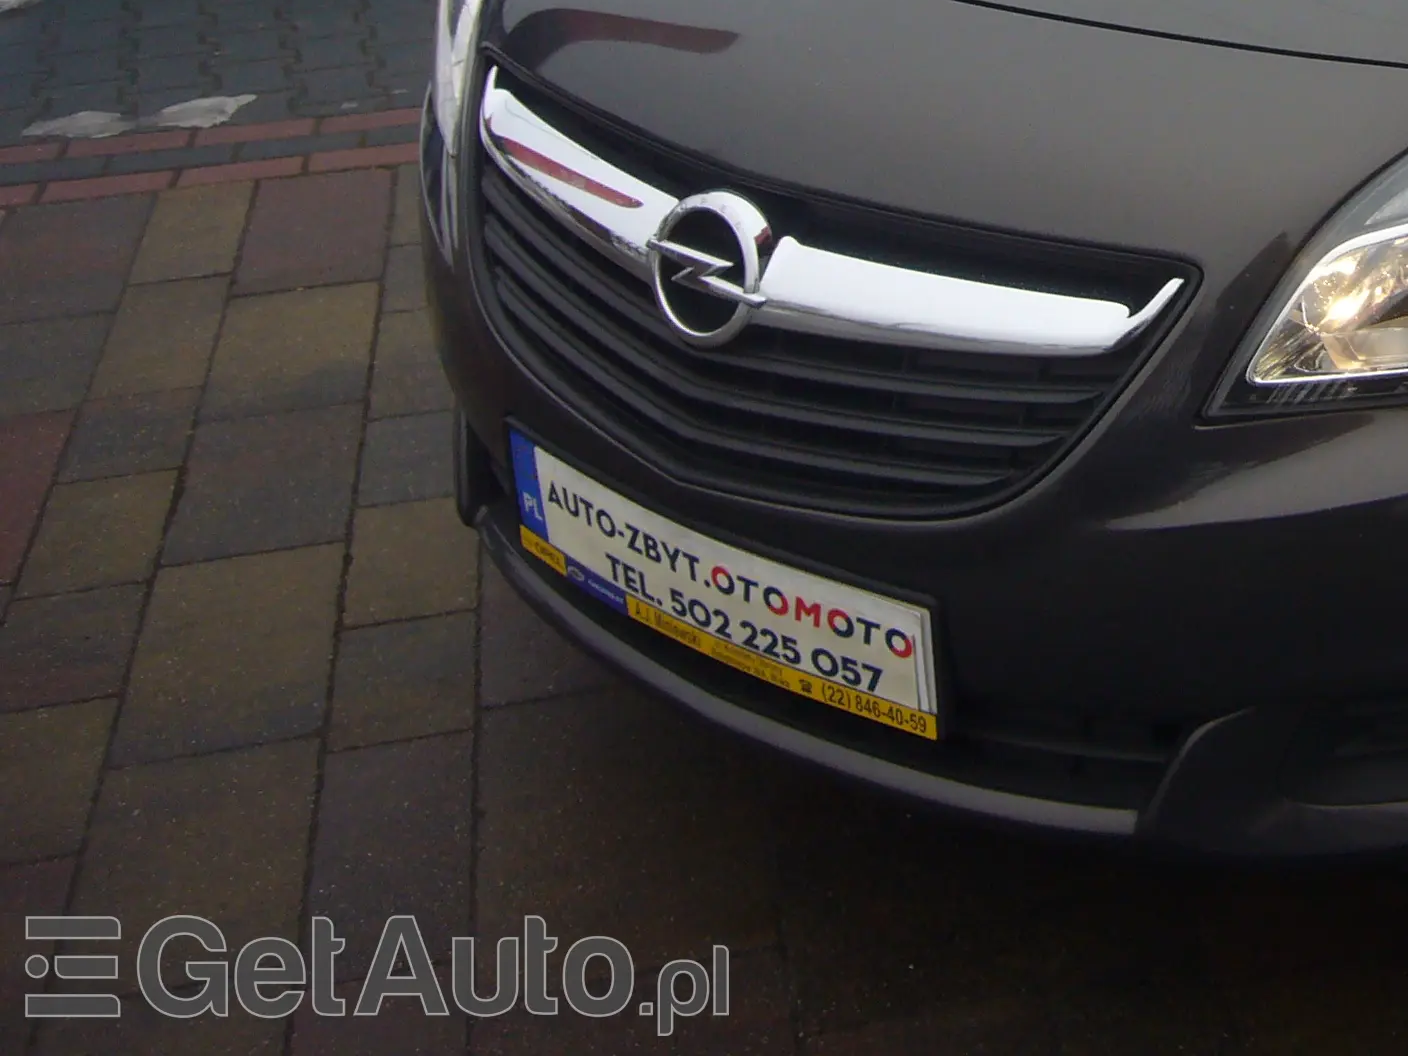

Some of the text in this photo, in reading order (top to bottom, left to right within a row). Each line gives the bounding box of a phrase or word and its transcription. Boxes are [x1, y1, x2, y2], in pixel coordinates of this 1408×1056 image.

[523, 491, 543, 522] PL
[605, 552, 664, 606] TEL.
[670, 589, 732, 640] 502
[740, 620, 802, 665] 225
[811, 647, 884, 693] 057
[821, 682, 928, 734] (22) 846-40-59
